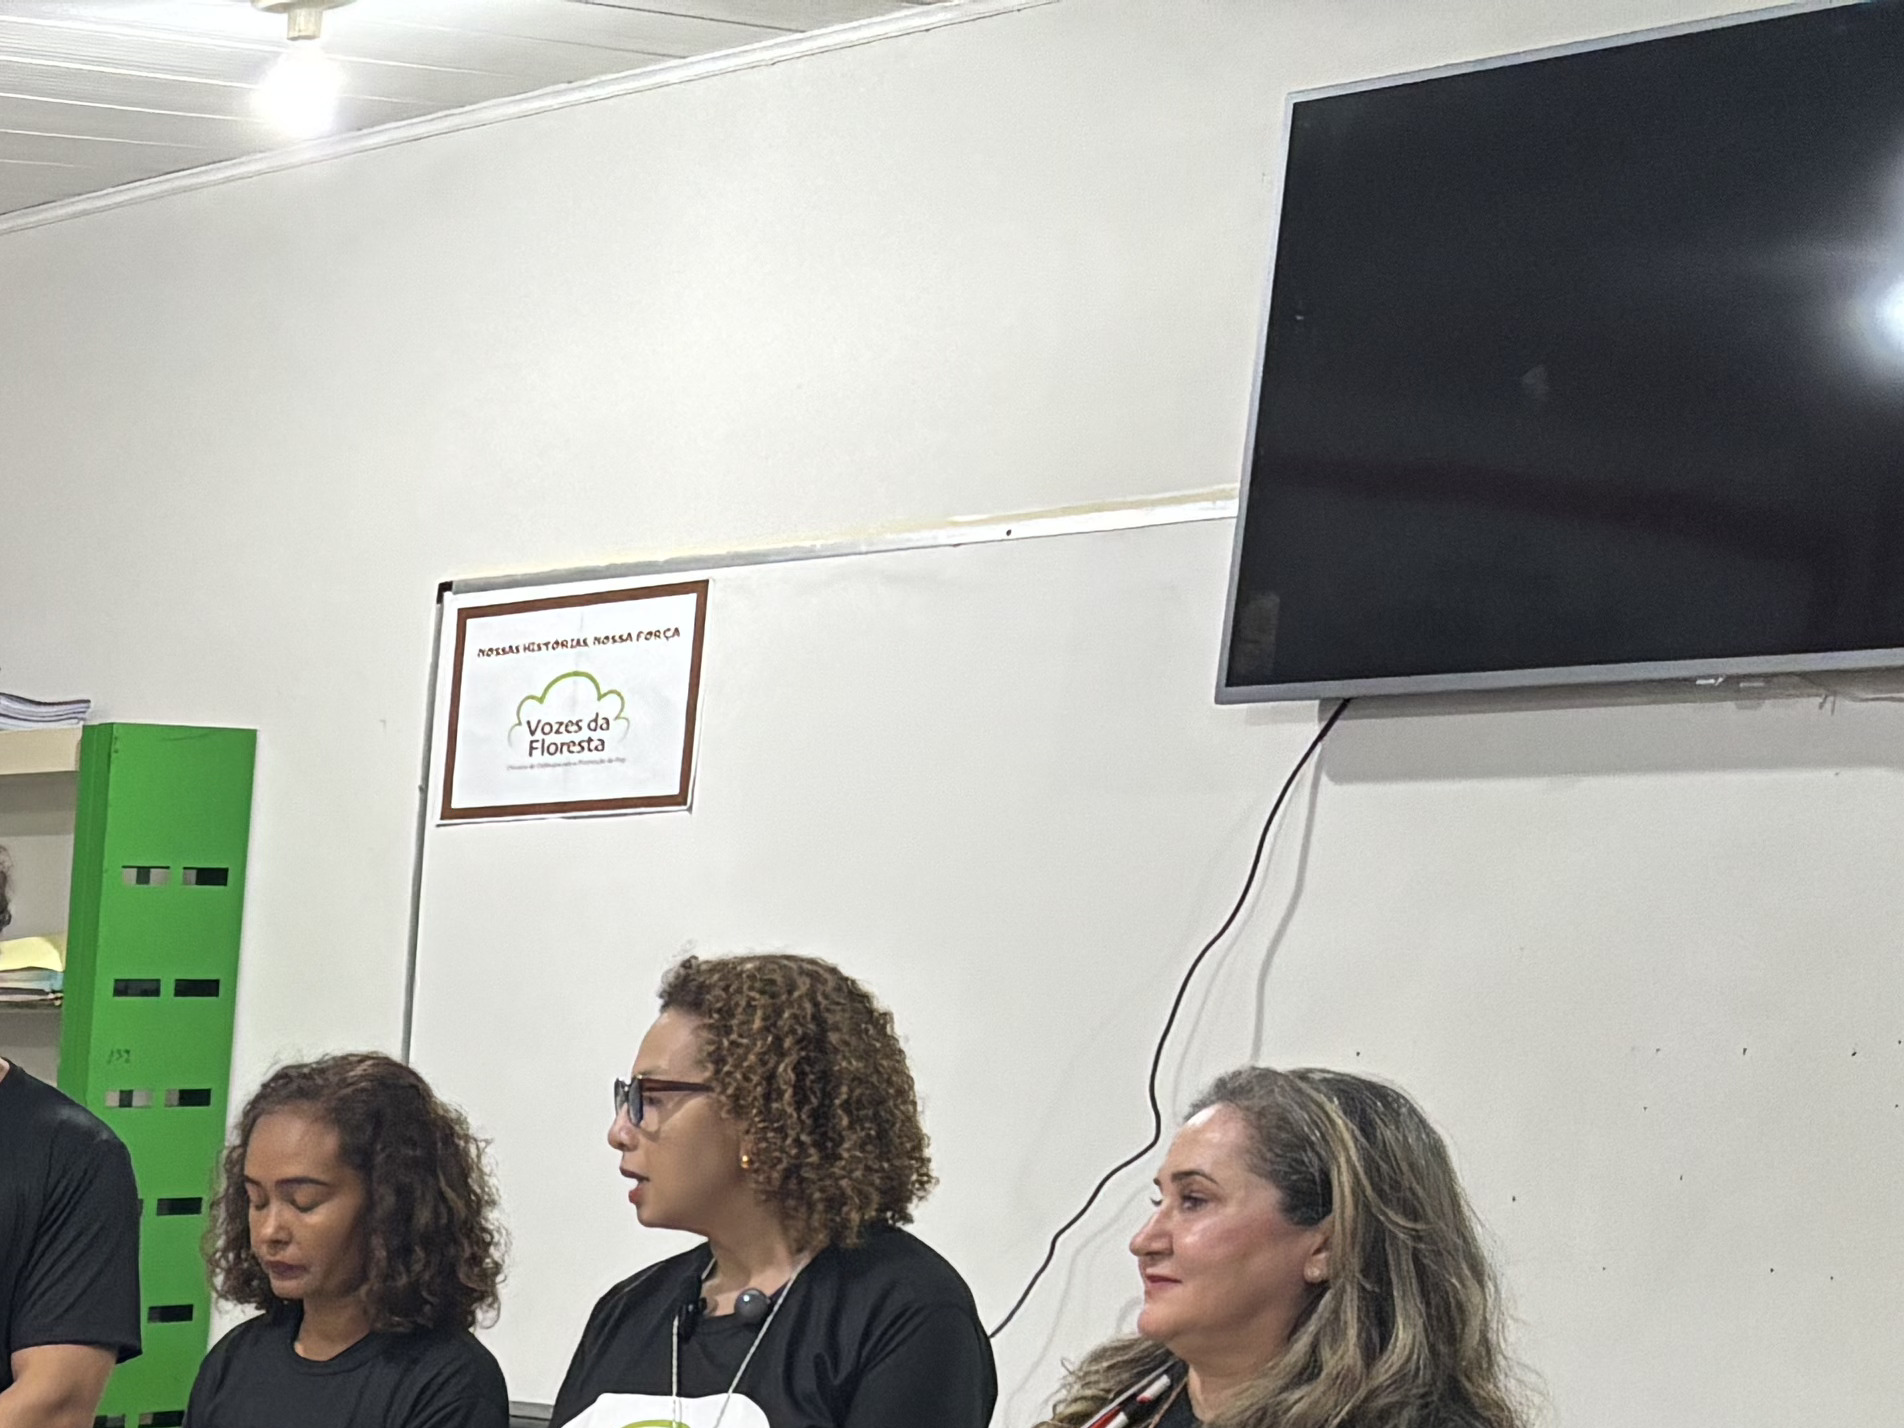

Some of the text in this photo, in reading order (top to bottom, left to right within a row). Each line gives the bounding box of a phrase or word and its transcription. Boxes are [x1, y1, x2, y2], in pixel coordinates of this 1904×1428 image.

[526, 713, 610, 737] Vozes da
[529, 736, 606, 757] Floresta
